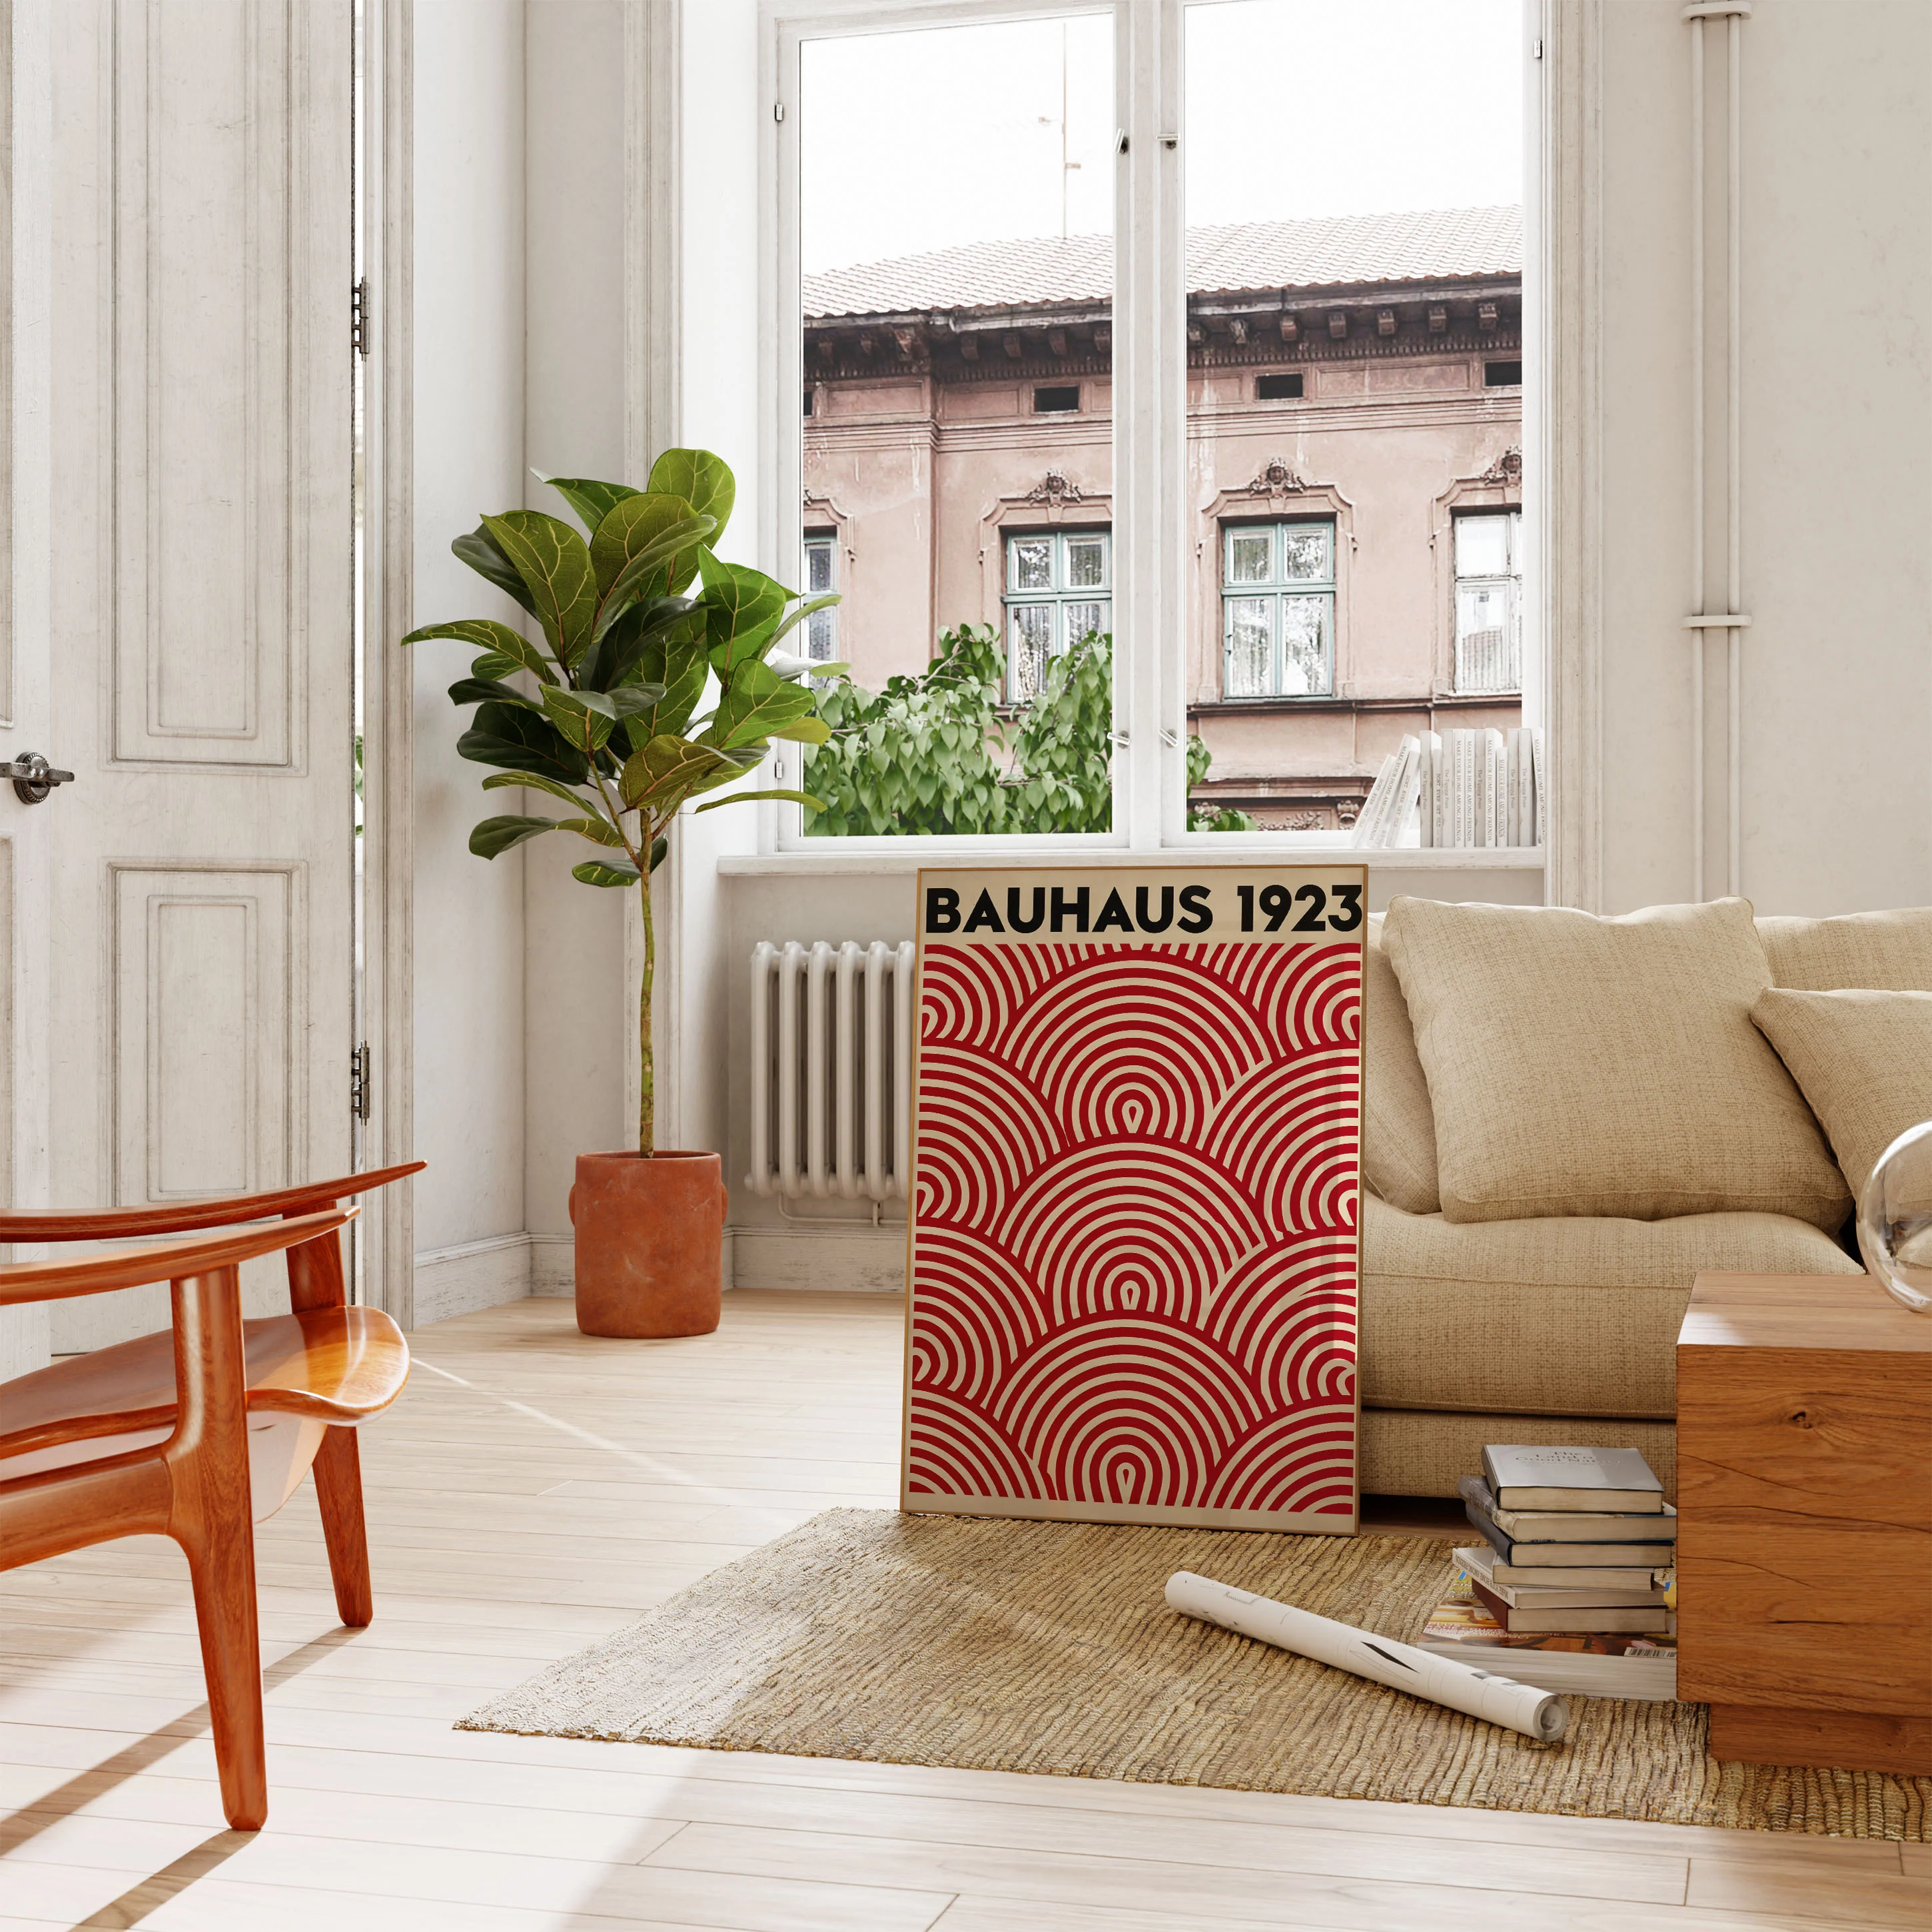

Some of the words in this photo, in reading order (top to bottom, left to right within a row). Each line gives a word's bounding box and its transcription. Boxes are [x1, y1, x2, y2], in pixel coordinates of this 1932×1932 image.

[1398, 745, 1407, 759] MAKE
[1392, 761, 1402, 777] YOUR
[1386, 778, 1396, 795] HOME
[1378, 797, 1388, 817] AMONG
[1369, 817, 1381, 841] FRIENDS
[926, 885, 1213, 933] BAUHAUS
[1237, 884, 1363, 933] 1923
